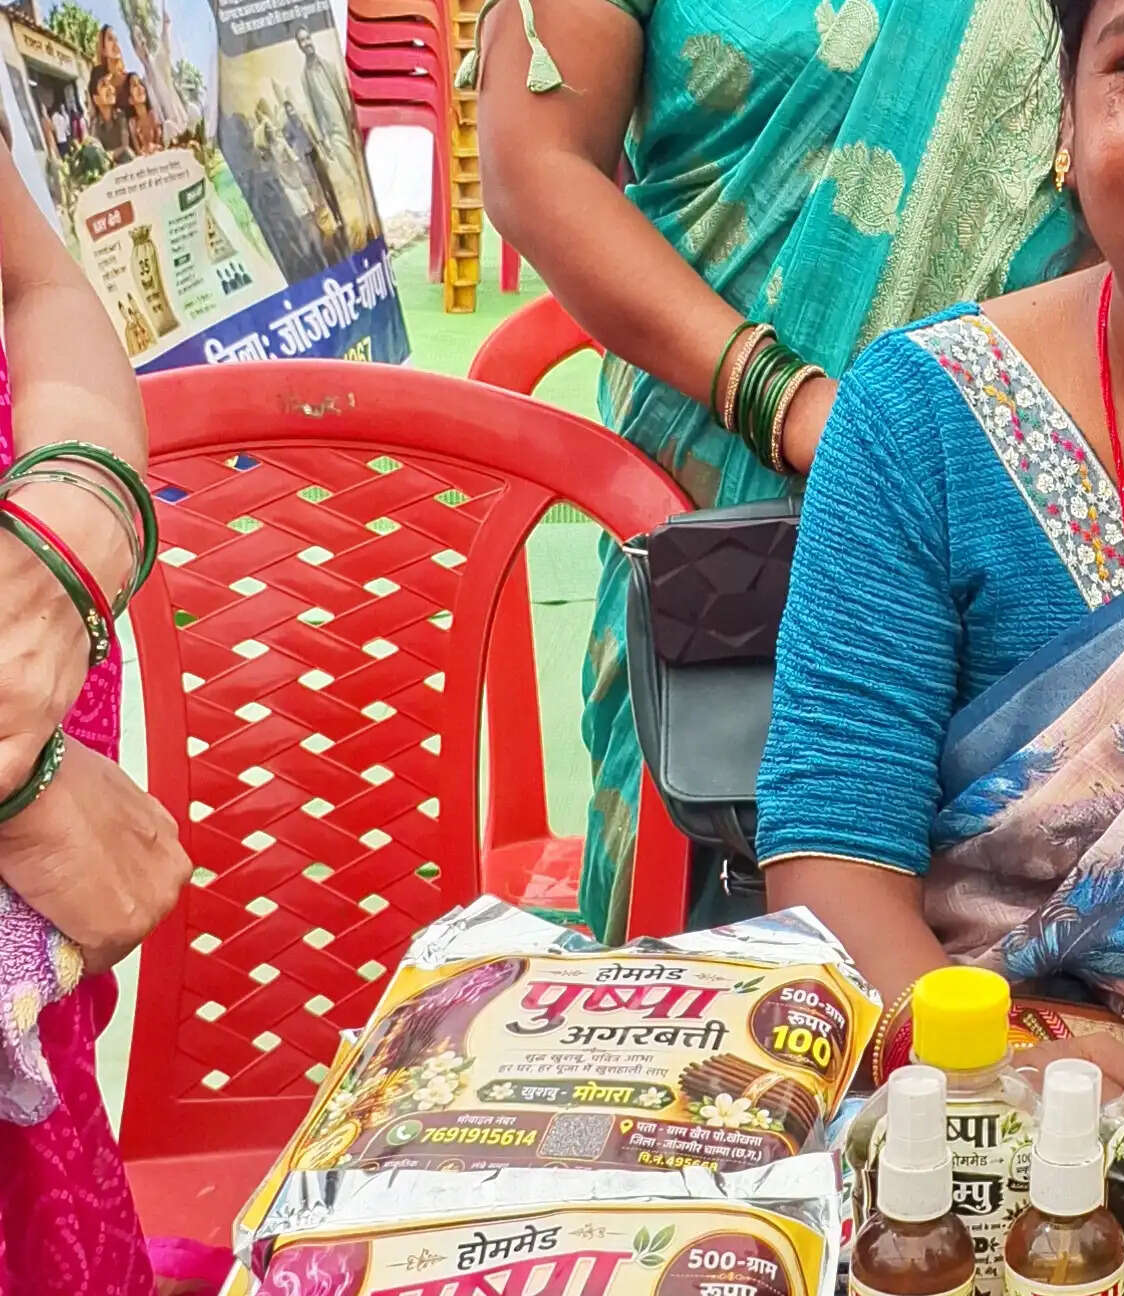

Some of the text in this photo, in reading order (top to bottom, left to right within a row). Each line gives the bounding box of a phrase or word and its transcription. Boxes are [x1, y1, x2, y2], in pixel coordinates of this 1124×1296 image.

[596, 964, 687, 984] होममेड
[506, 981, 732, 1035] पुष्पा
[779, 986, 846, 1027] 500-ग्राम
[560, 1022, 730, 1052] अगरबत्ती
[772, 1024, 831, 1068] 100
[572, 1080, 635, 1103] मोगरा
[420, 1126, 538, 1147] 7691915614
[457, 1225, 563, 1273] होममेड
[687, 1248, 779, 1281] 500-ग्राम
